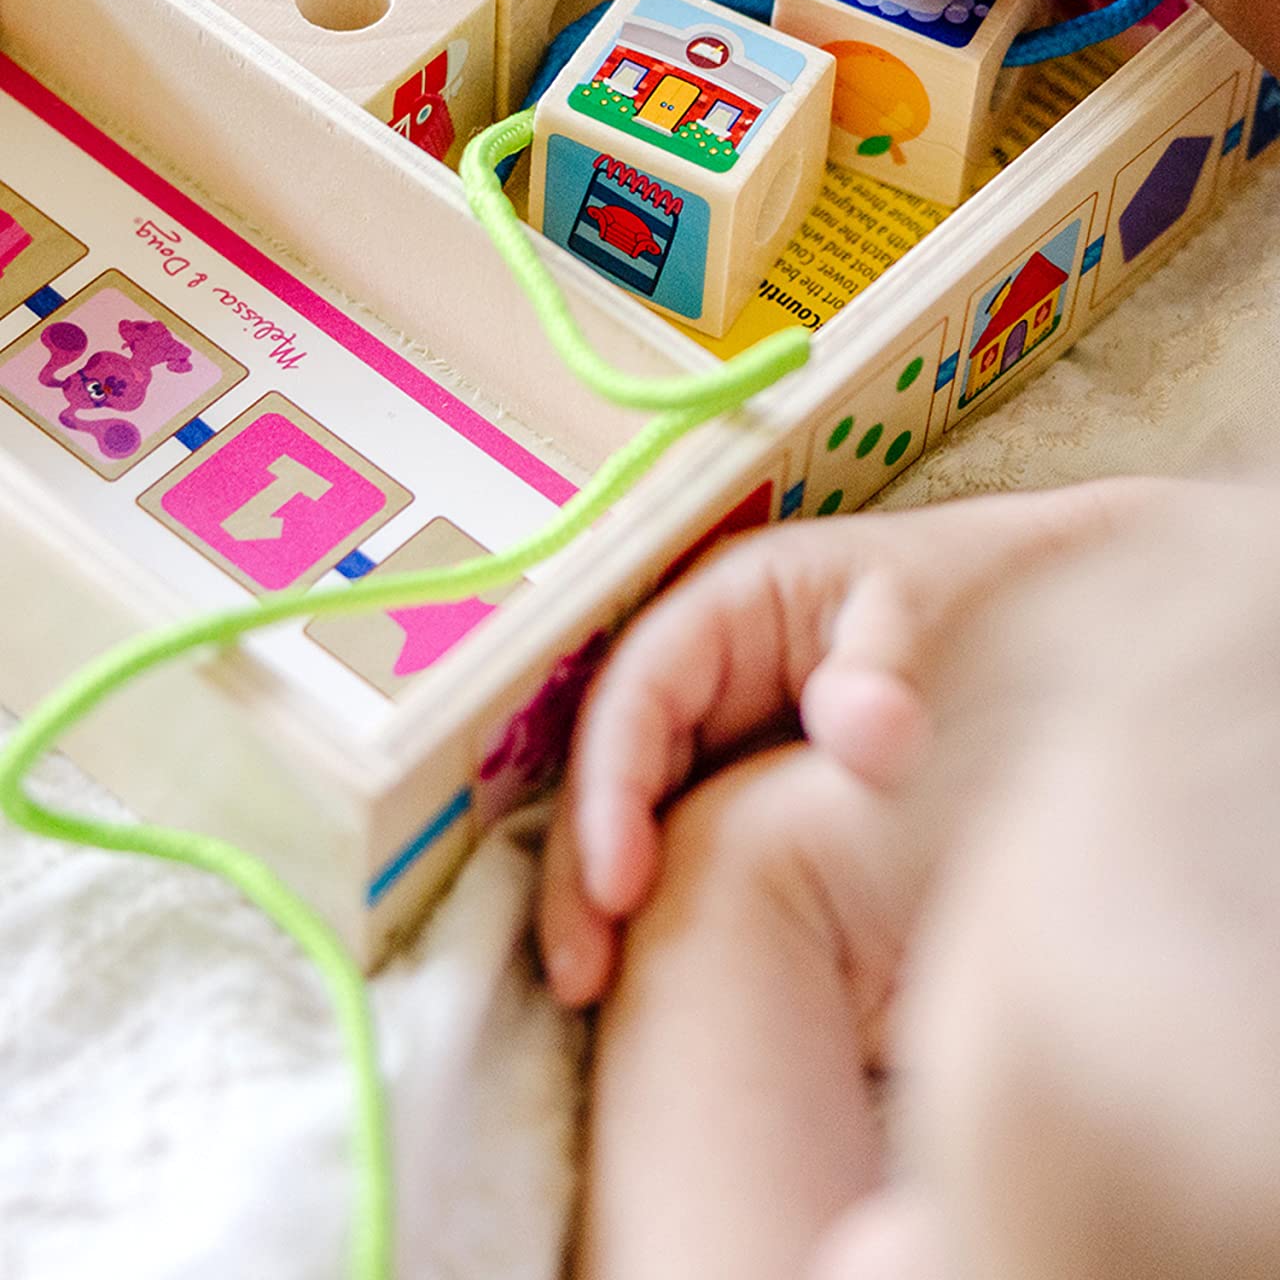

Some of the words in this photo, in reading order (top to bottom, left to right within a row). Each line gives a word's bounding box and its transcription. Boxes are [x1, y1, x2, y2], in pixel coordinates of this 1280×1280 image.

[837, 224, 862, 245] the
[887, 207, 929, 239] hoose
[135, 220, 191, 277] Doug
[787, 239, 816, 265] Cou
[821, 240, 852, 263] and
[187, 272, 208, 288] &
[773, 257, 801, 282] bea
[816, 260, 859, 294] tower.
[799, 275, 824, 297] the
[821, 291, 846, 310] ort
[212, 287, 308, 370] Melissa
[219, 453, 334, 541] 1
